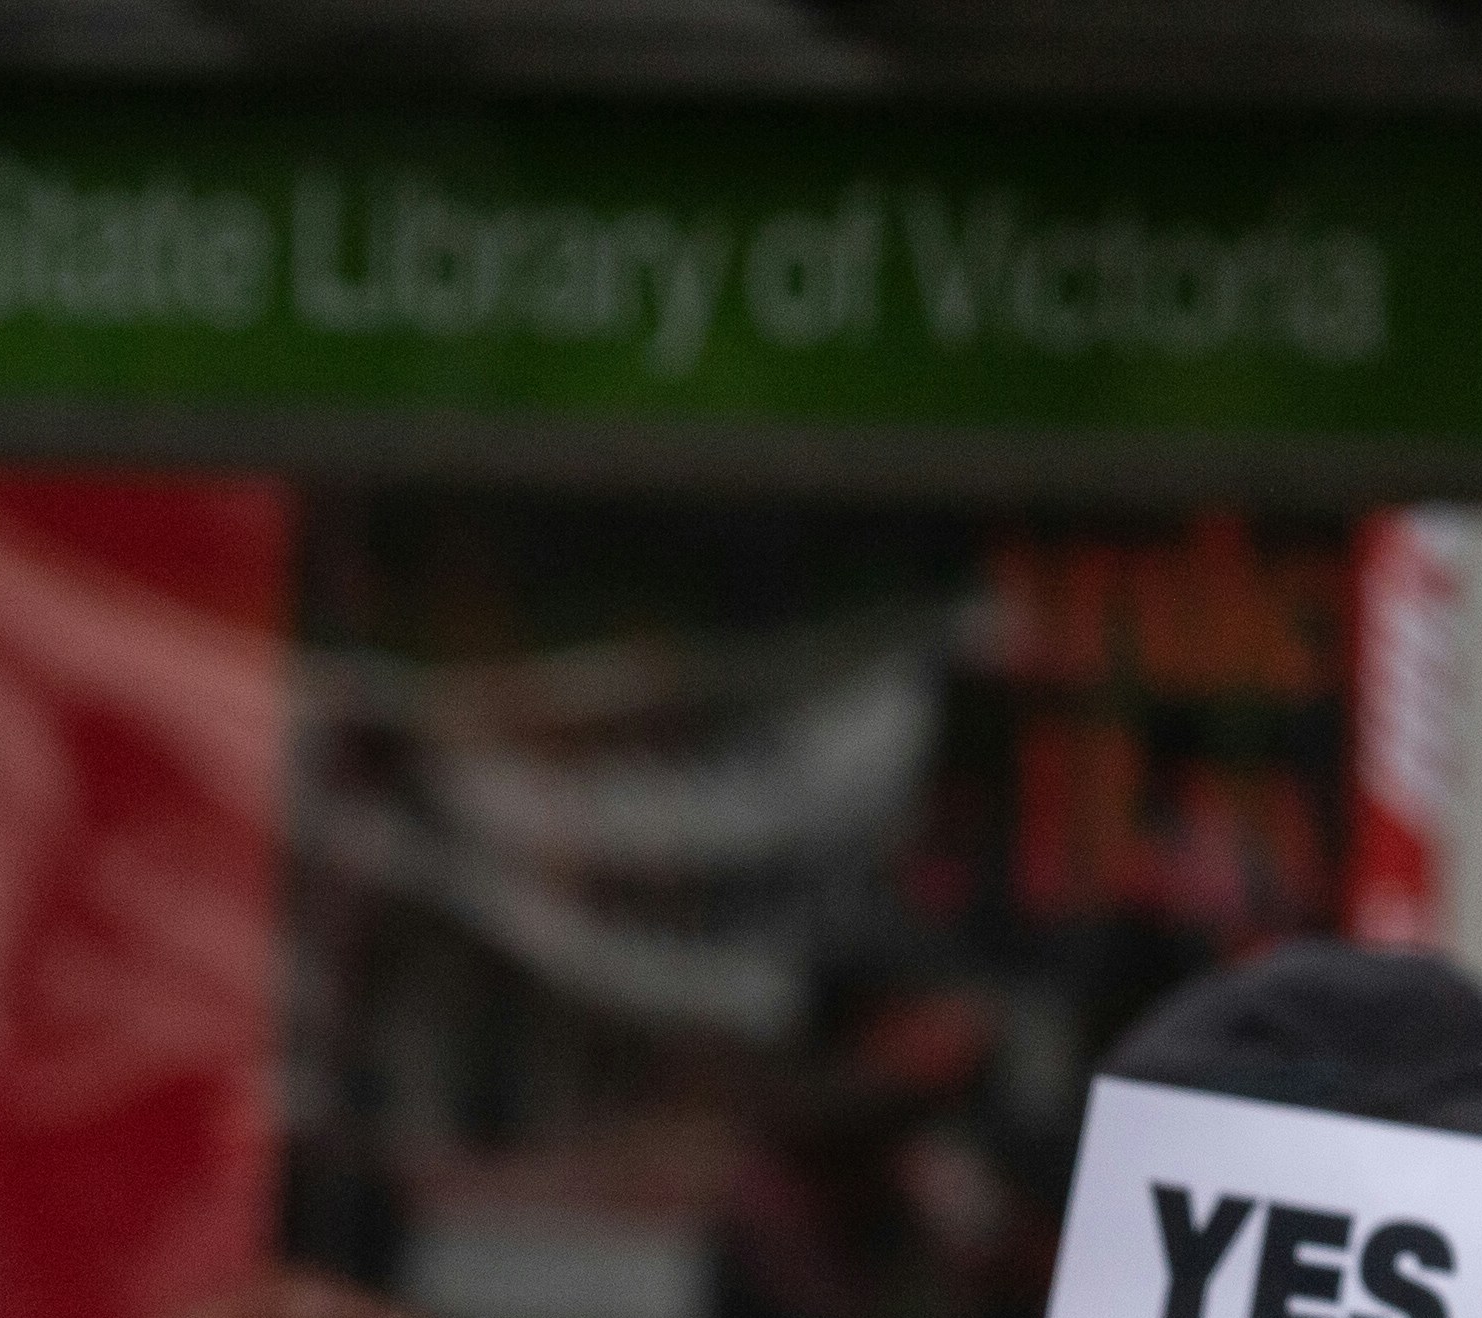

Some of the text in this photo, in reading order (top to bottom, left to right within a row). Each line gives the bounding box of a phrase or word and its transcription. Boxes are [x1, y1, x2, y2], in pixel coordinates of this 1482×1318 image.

[294, 164, 731, 378] Library
[745, 178, 890, 349] of
[900, 183, 1390, 364] Victoria
